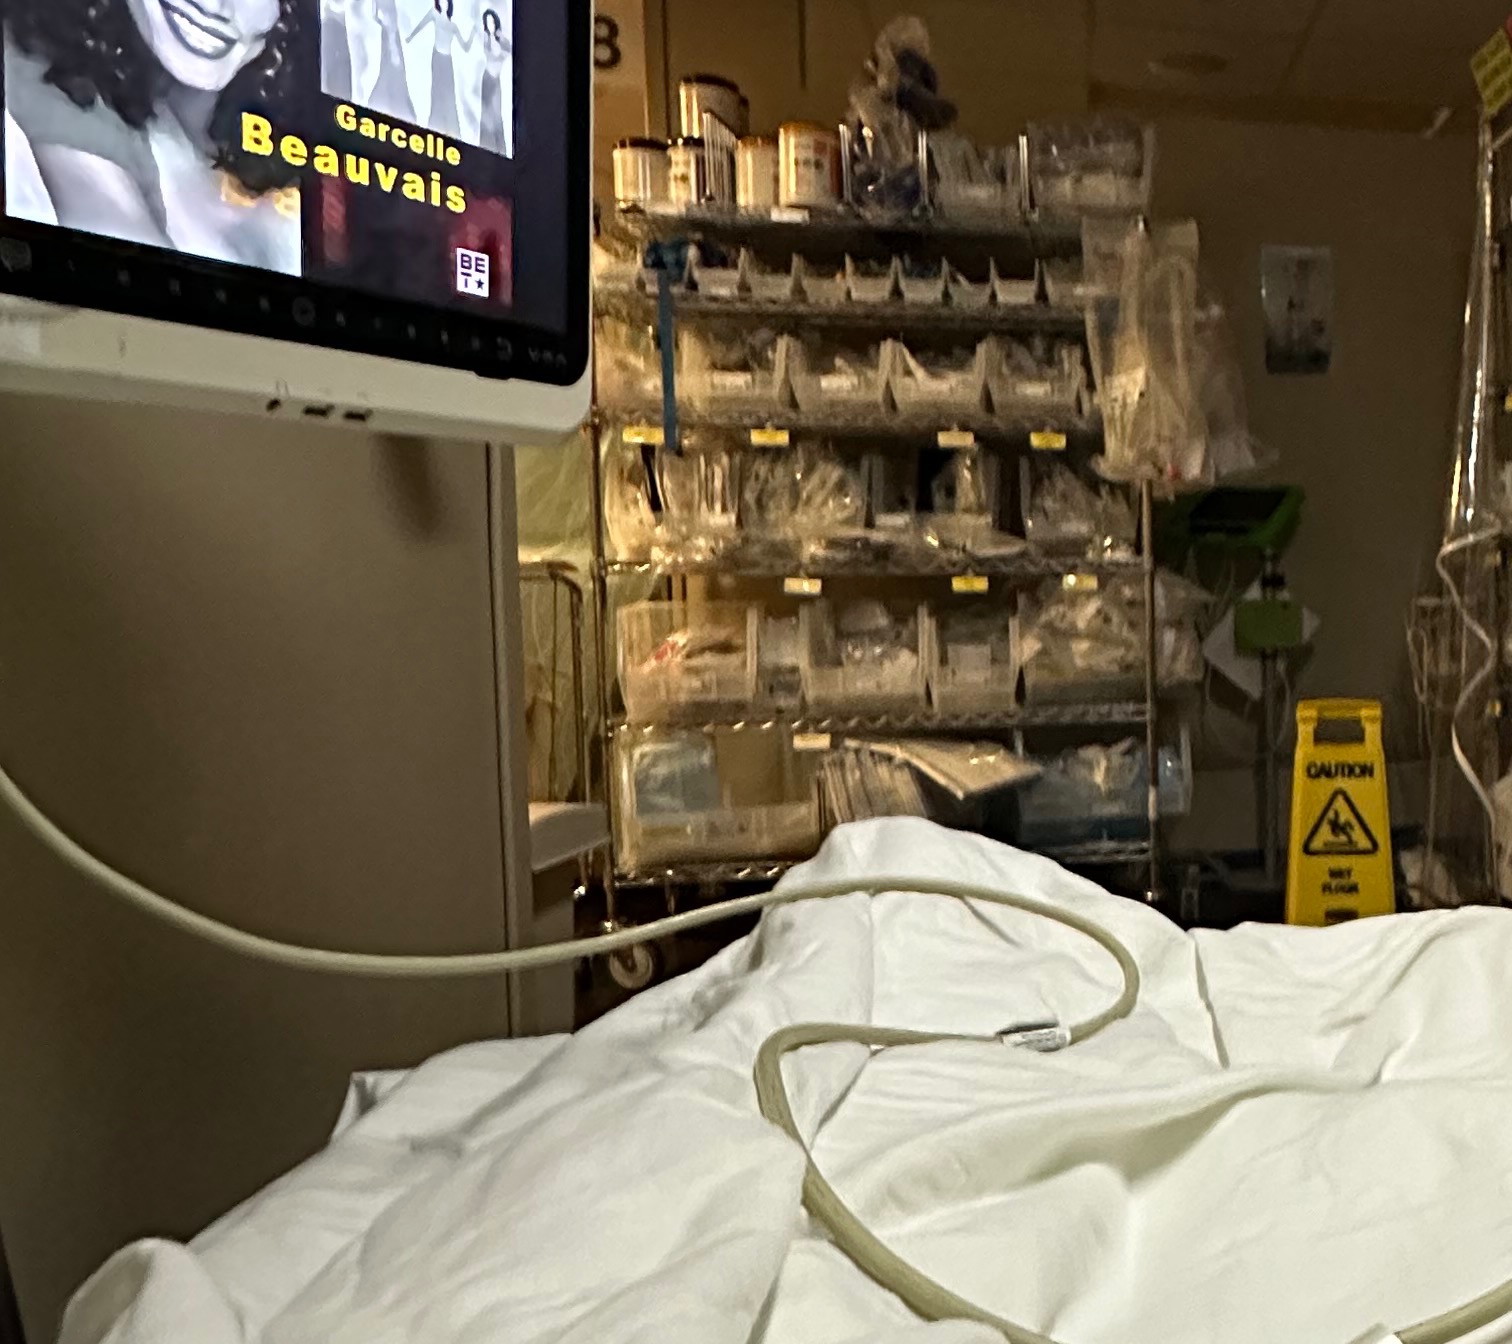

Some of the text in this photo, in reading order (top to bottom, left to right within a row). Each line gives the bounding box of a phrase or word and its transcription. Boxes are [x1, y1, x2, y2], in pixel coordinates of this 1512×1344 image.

[241, 111, 467, 214] Beauvais
[335, 104, 462, 166] Garcelle
[1306, 761, 1375, 780] CAUTION
